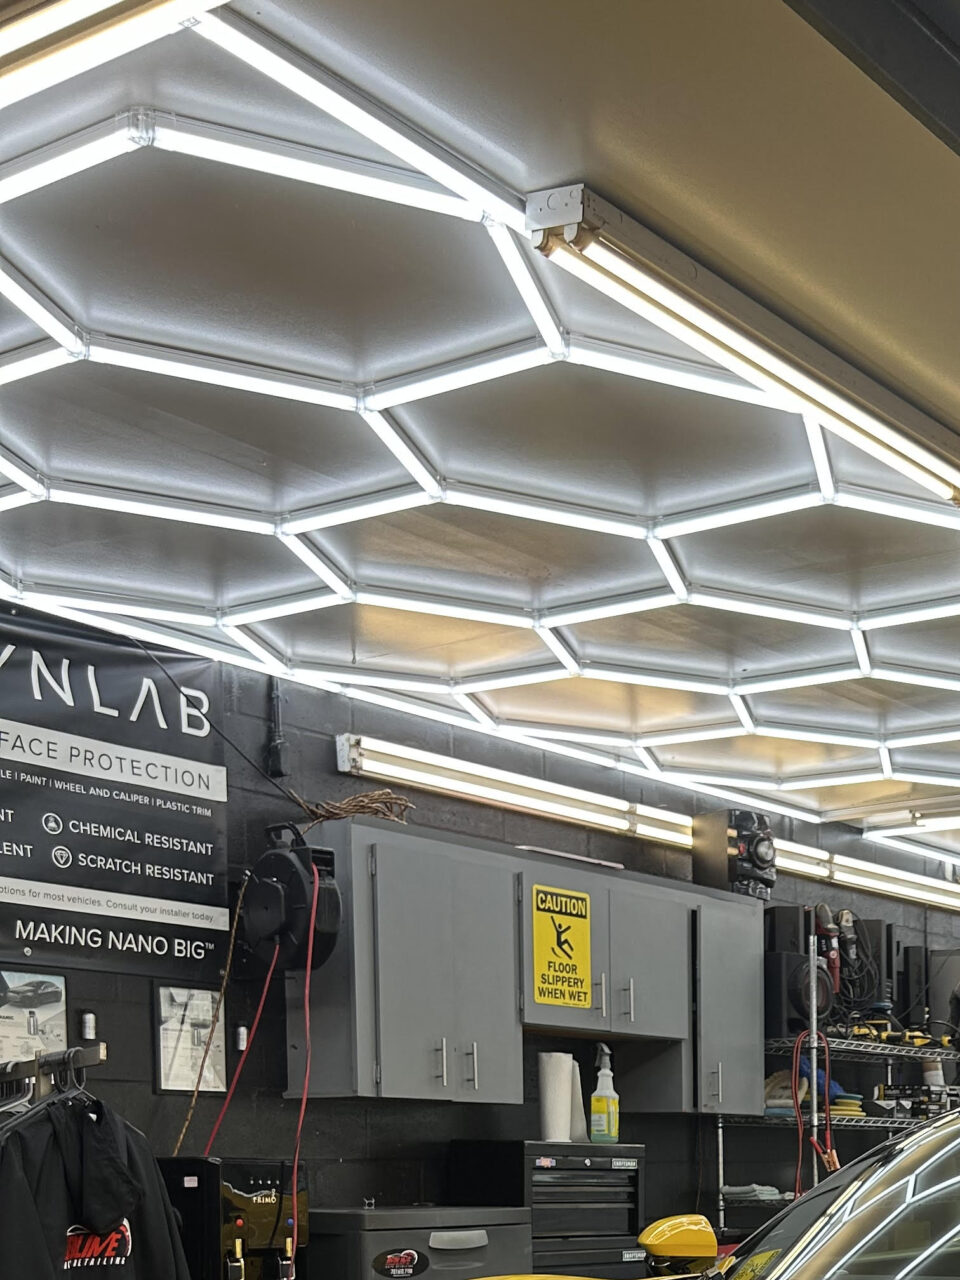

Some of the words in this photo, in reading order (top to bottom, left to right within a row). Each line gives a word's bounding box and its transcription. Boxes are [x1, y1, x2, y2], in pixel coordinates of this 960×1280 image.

[69, 745, 210, 791] PROTECTION
[20, 773, 47, 786] PAINT
[54, 780, 86, 794] WHEEL
[89, 786, 110, 798] AND
[113, 791, 149, 805] CALIPER
[156, 798, 190, 813] PLASTIC
[192, 805, 212, 817] TRIM
[69, 820, 141, 844] CHEMICAL
[145, 832, 214, 856] RESISTANT
[78, 853, 141, 875] SCRATCH
[145, 864, 215, 886] RESISTANT
[28, 888, 41, 898] for
[43, 892, 65, 902] most
[105, 899, 138, 912] Consult
[139, 906, 158, 915] your
[159, 907, 190, 918] installer
[537, 892, 586, 916] CAUTION
[15, 919, 102, 948] MAKING
[107, 930, 168, 955] NANO
[540, 973, 585, 989] SLIPPERY
[547, 960, 578, 975] FLOOR
[537, 986, 566, 1000] WHEN
[568, 990, 588, 1003] WET
